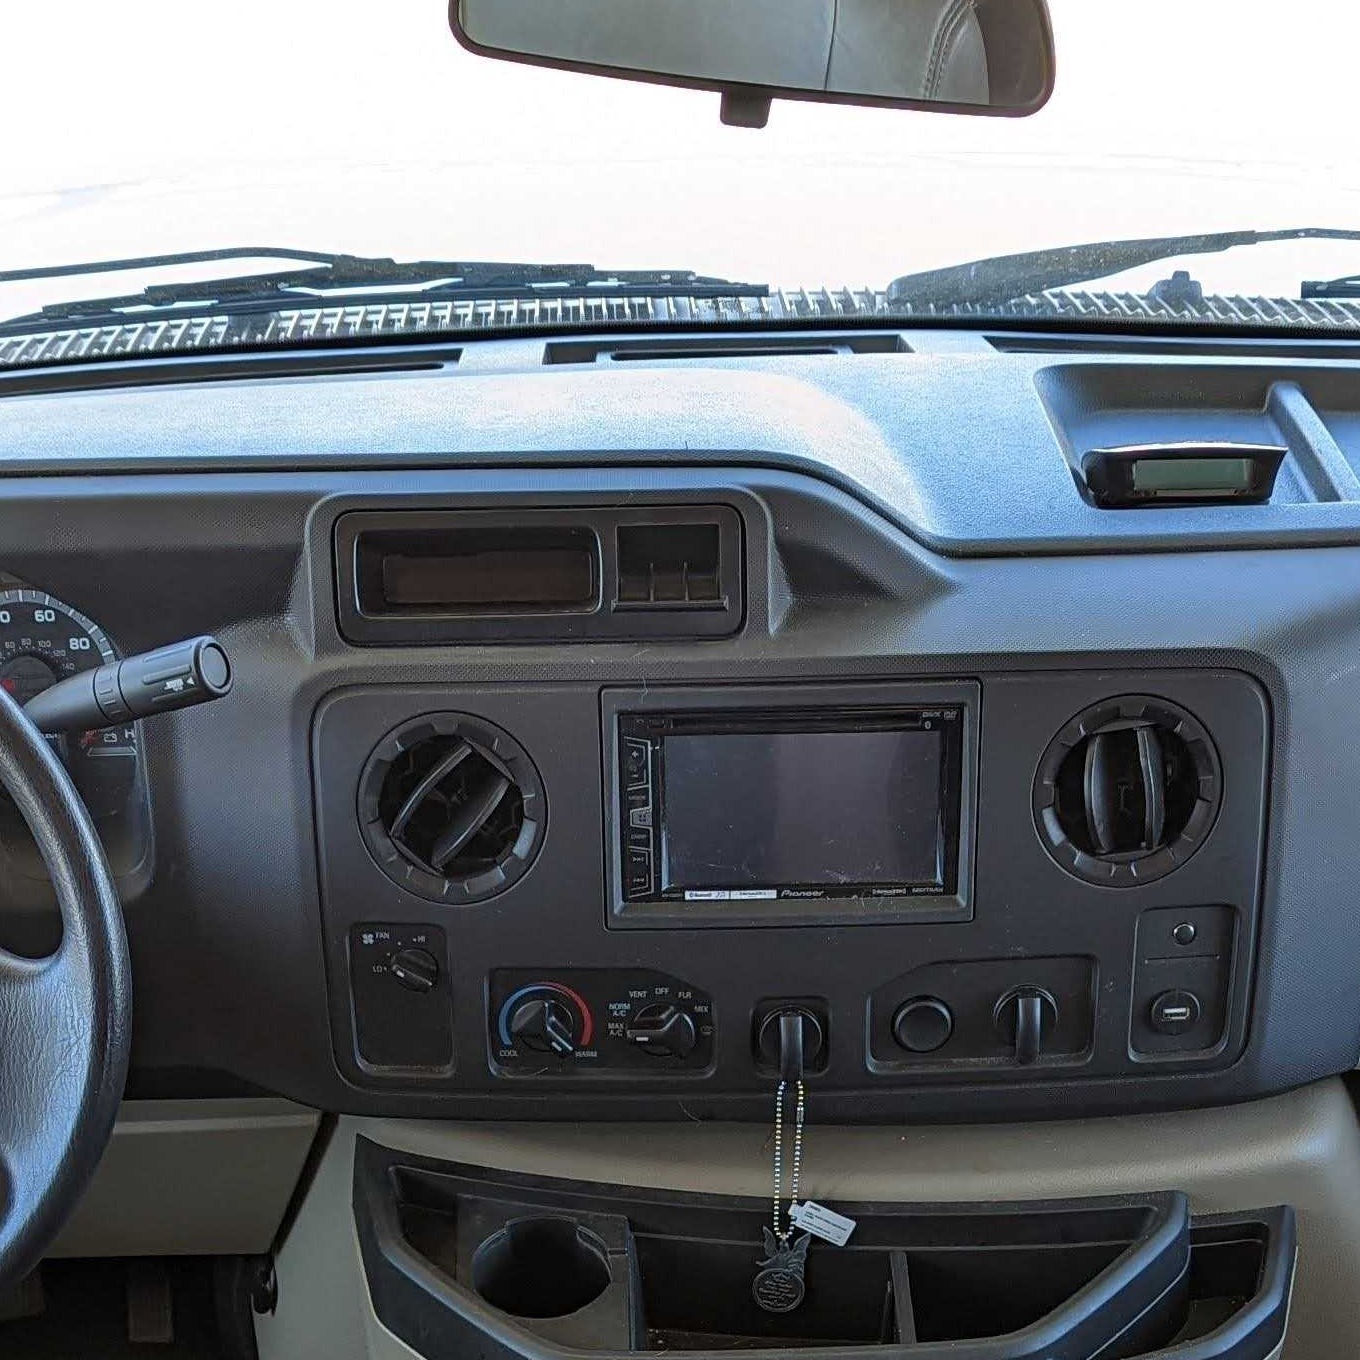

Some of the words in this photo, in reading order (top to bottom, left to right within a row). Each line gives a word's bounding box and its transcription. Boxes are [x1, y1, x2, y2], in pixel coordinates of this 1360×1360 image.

[34, 609, 56, 623] 60
[68, 637, 91, 651] 80
[780, 889, 825, 898] Pioneer
[628, 990, 648, 998] VENT
[654, 987, 670, 995] OFF
[608, 1003, 631, 1011] NORM
[607, 1022, 625, 1030] MAX
[499, 1049, 518, 1057] COOL
